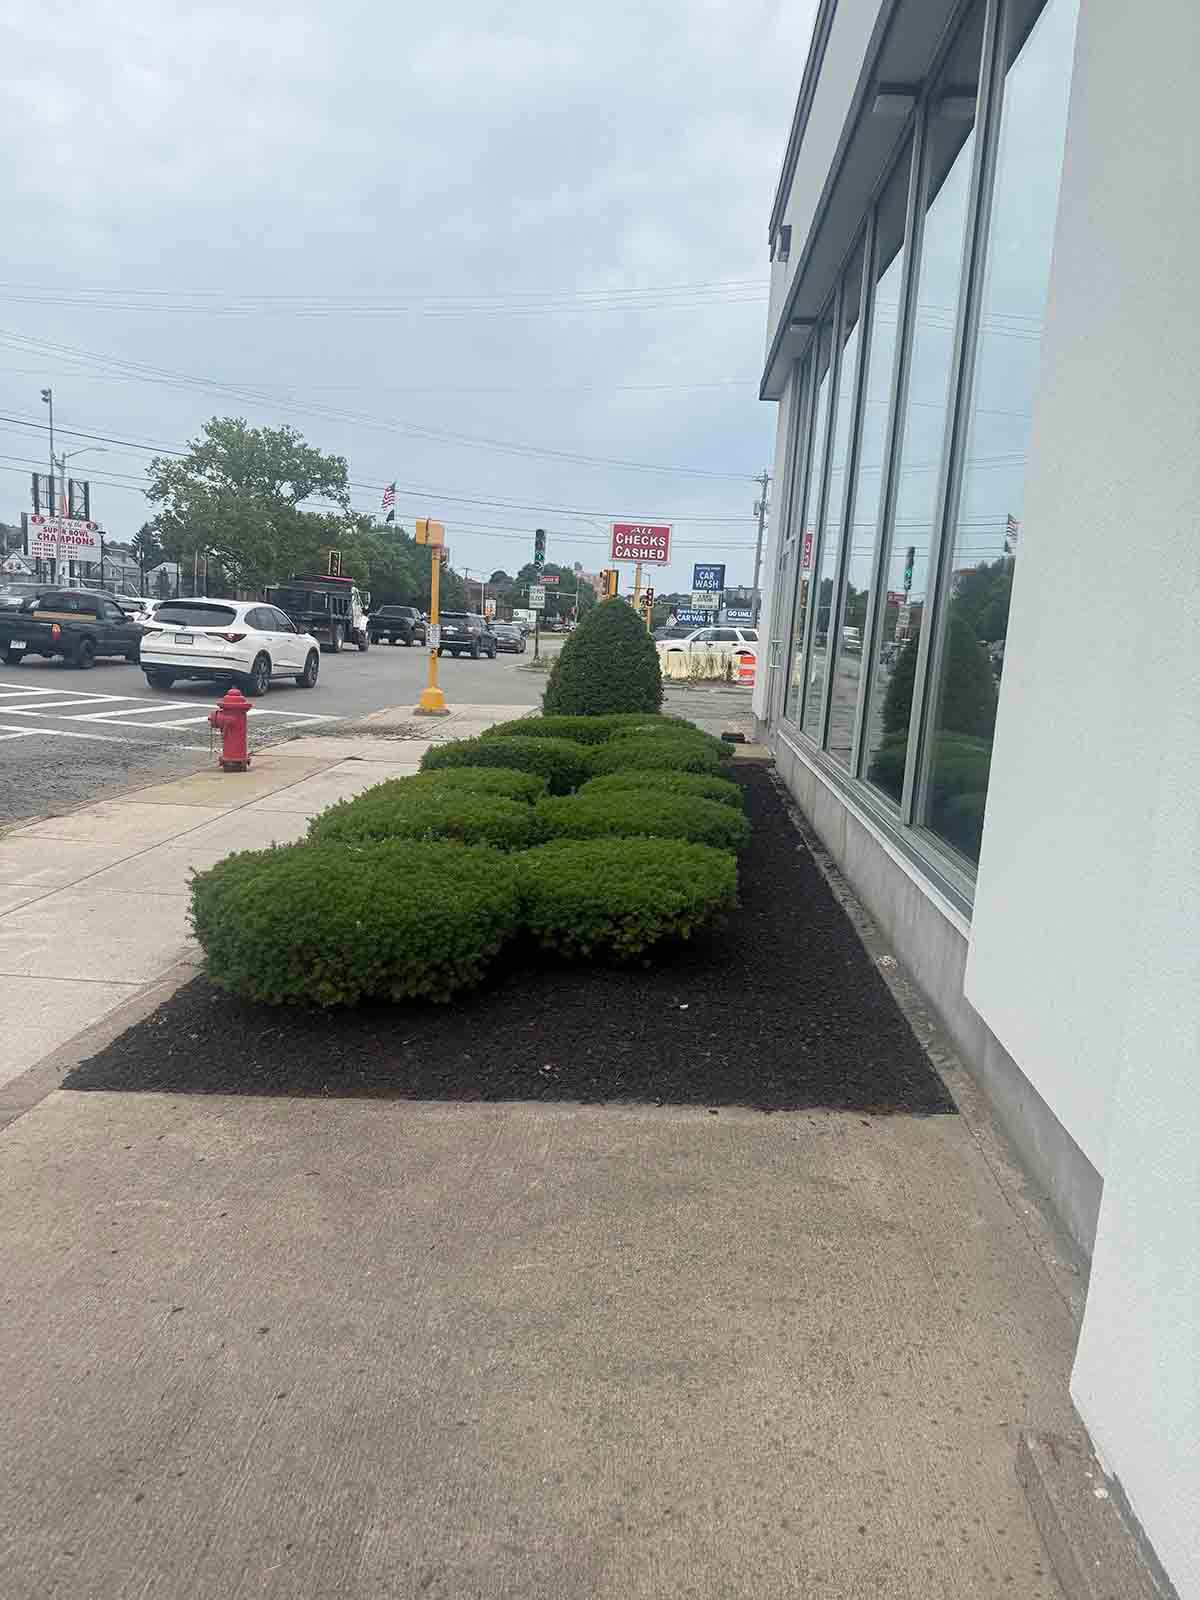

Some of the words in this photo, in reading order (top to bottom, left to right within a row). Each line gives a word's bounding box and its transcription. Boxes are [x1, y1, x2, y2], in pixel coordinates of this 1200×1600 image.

[43, 527, 67, 535] SUPR
[68, 530, 89, 538] BOWL
[616, 532, 666, 547] CHECKS
[615, 545, 665, 559] CASHED
[699, 571, 715, 580] CAR
[695, 579, 719, 589] WASH
[692, 614, 713, 622] WAH
